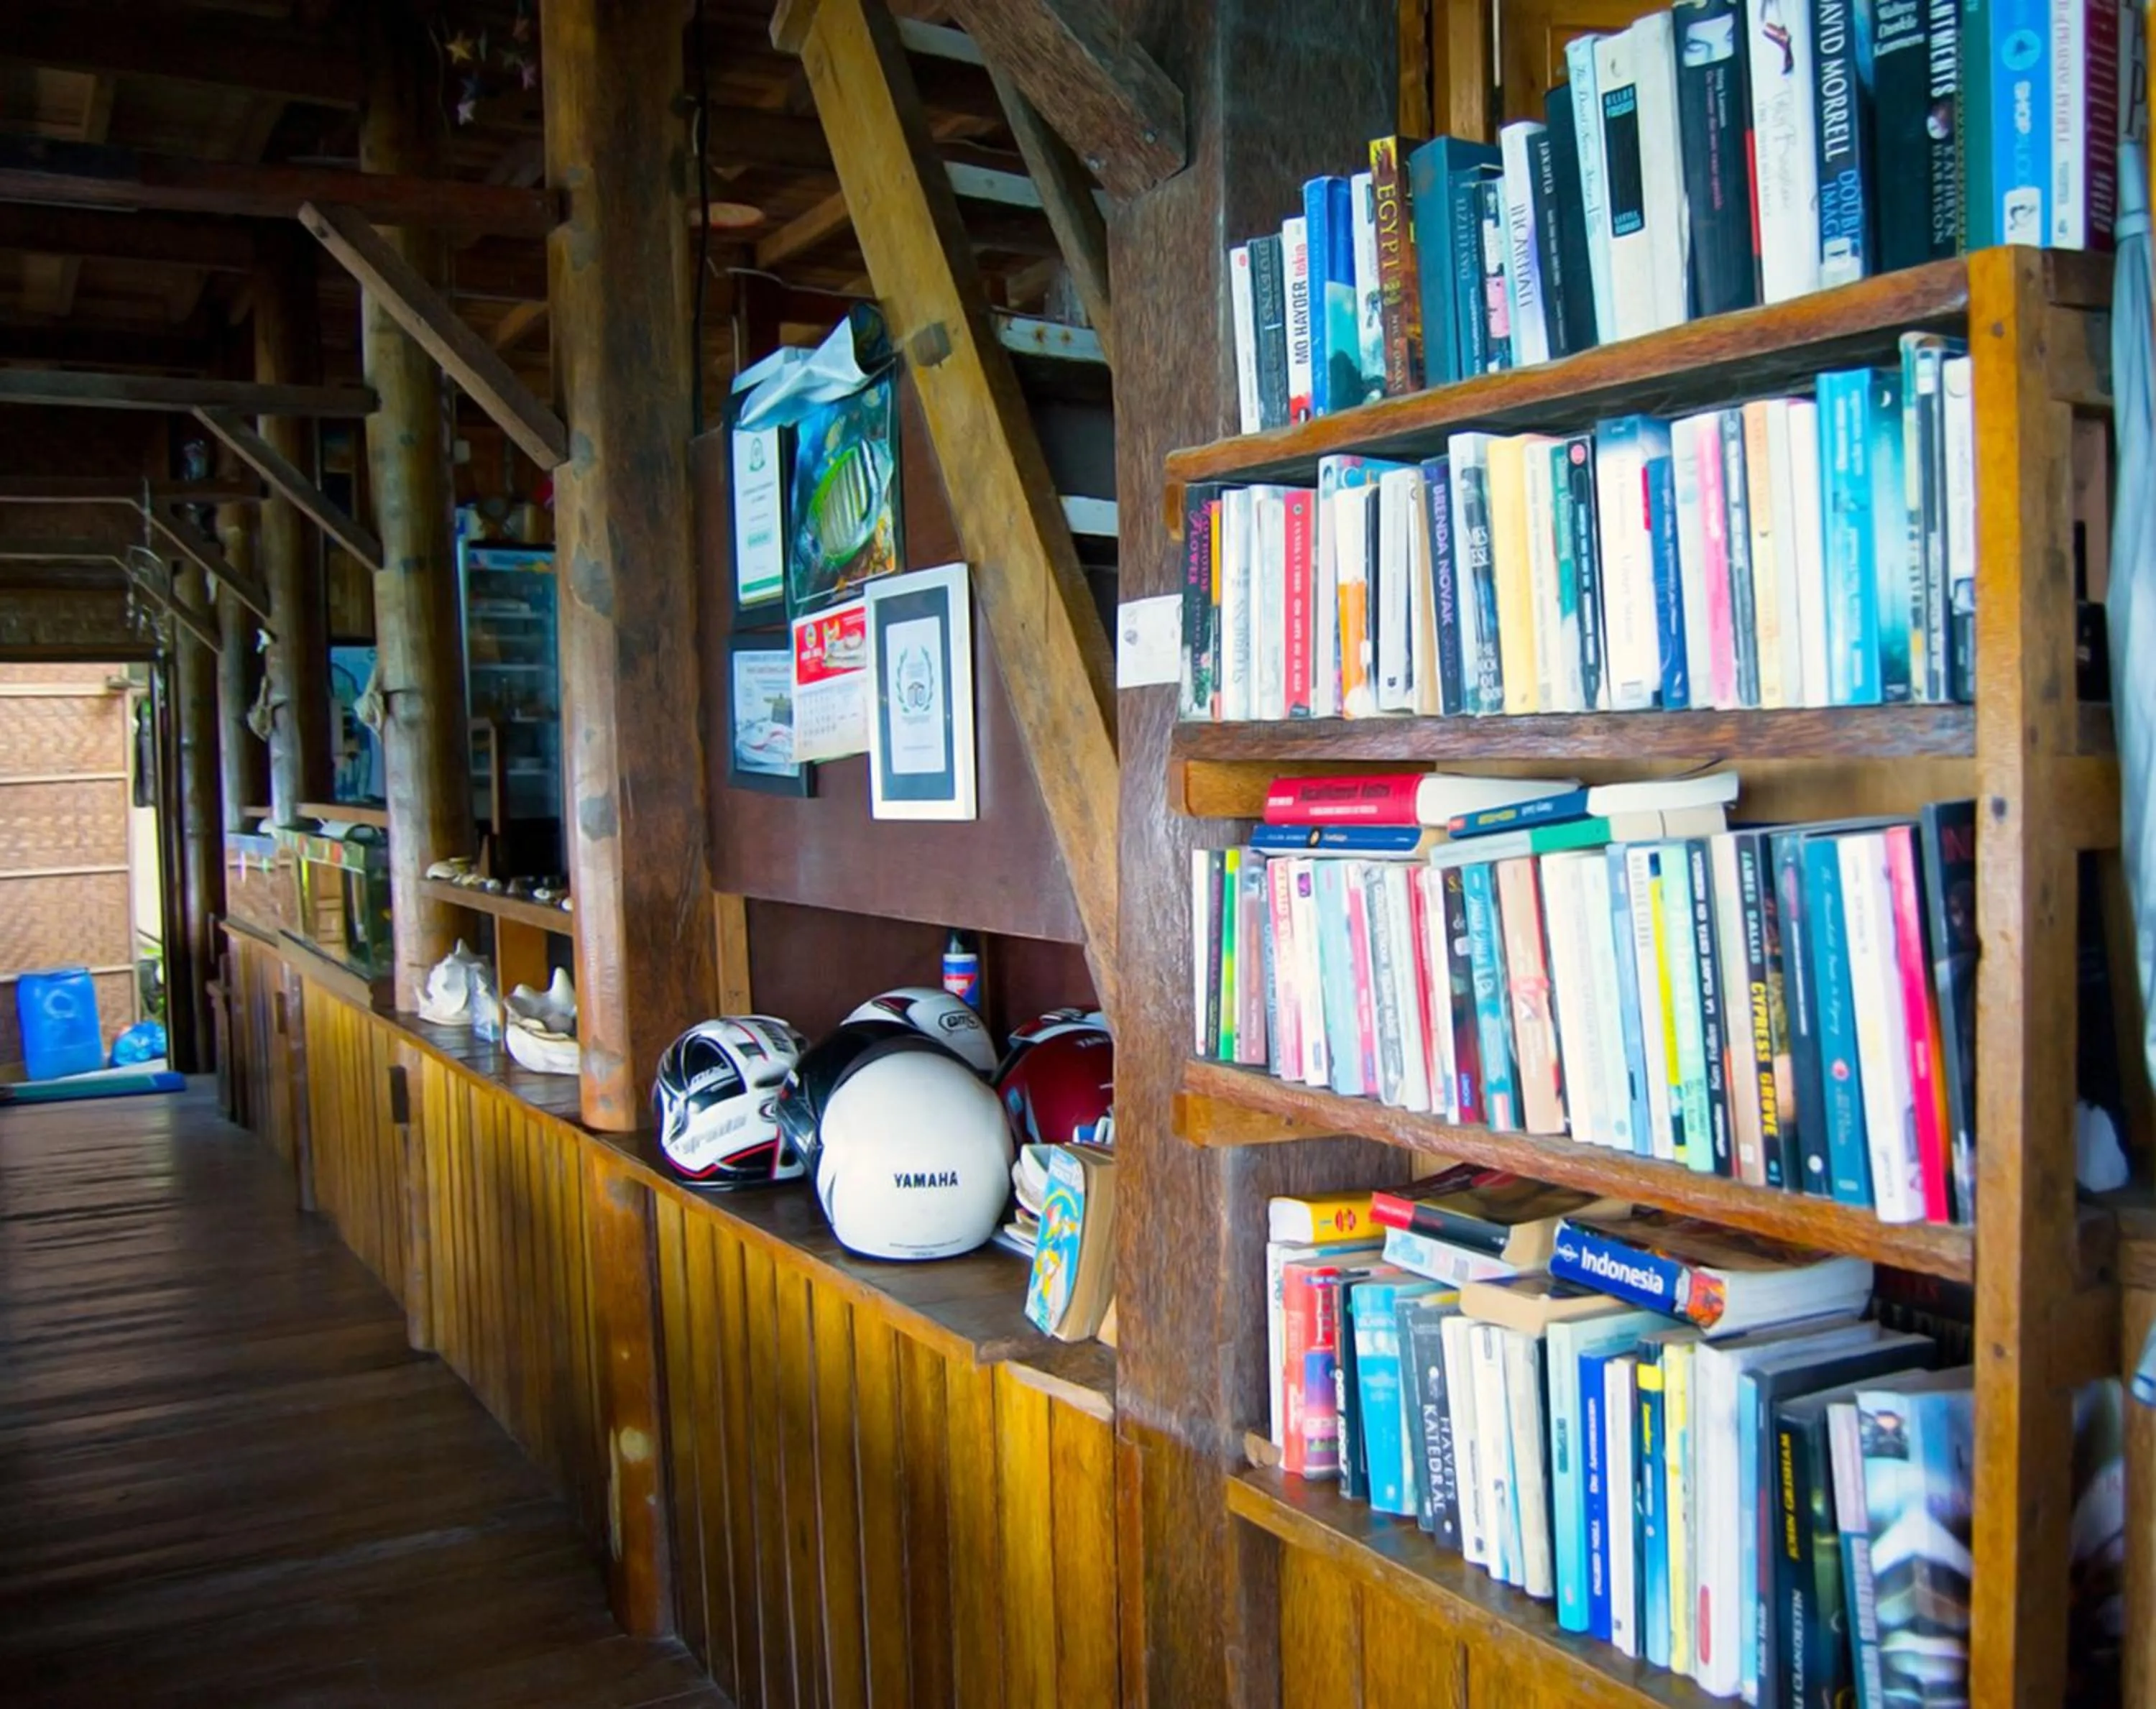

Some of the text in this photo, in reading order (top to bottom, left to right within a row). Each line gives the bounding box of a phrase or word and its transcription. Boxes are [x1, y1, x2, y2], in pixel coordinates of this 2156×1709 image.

[1820, 60, 1851, 163] MORRELL
[1537, 141, 1554, 195] Jakarta
[1930, 144, 1944, 244] HARRISON
[1943, 143, 1957, 239] KATHRYN
[1292, 281, 1308, 336] HAYDER
[1294, 340, 1309, 365] MO
[1187, 510, 1203, 585] FLOWER
[1432, 484, 1448, 554] BRENDA
[1438, 559, 1453, 625] NOVAK
[1740, 851, 1762, 964] JAMES SALLIS
[1749, 981, 1779, 1138] CYPRESS GROVE
[894, 1171, 959, 1189] YAMAHA
[1581, 1249, 1664, 1296] Indonesia
[1423, 1404, 1446, 1514] KATEDRAL
[1440, 1416, 1457, 1501] HAVETS
[1779, 1432, 1800, 1561] JOHN GRISHAM
